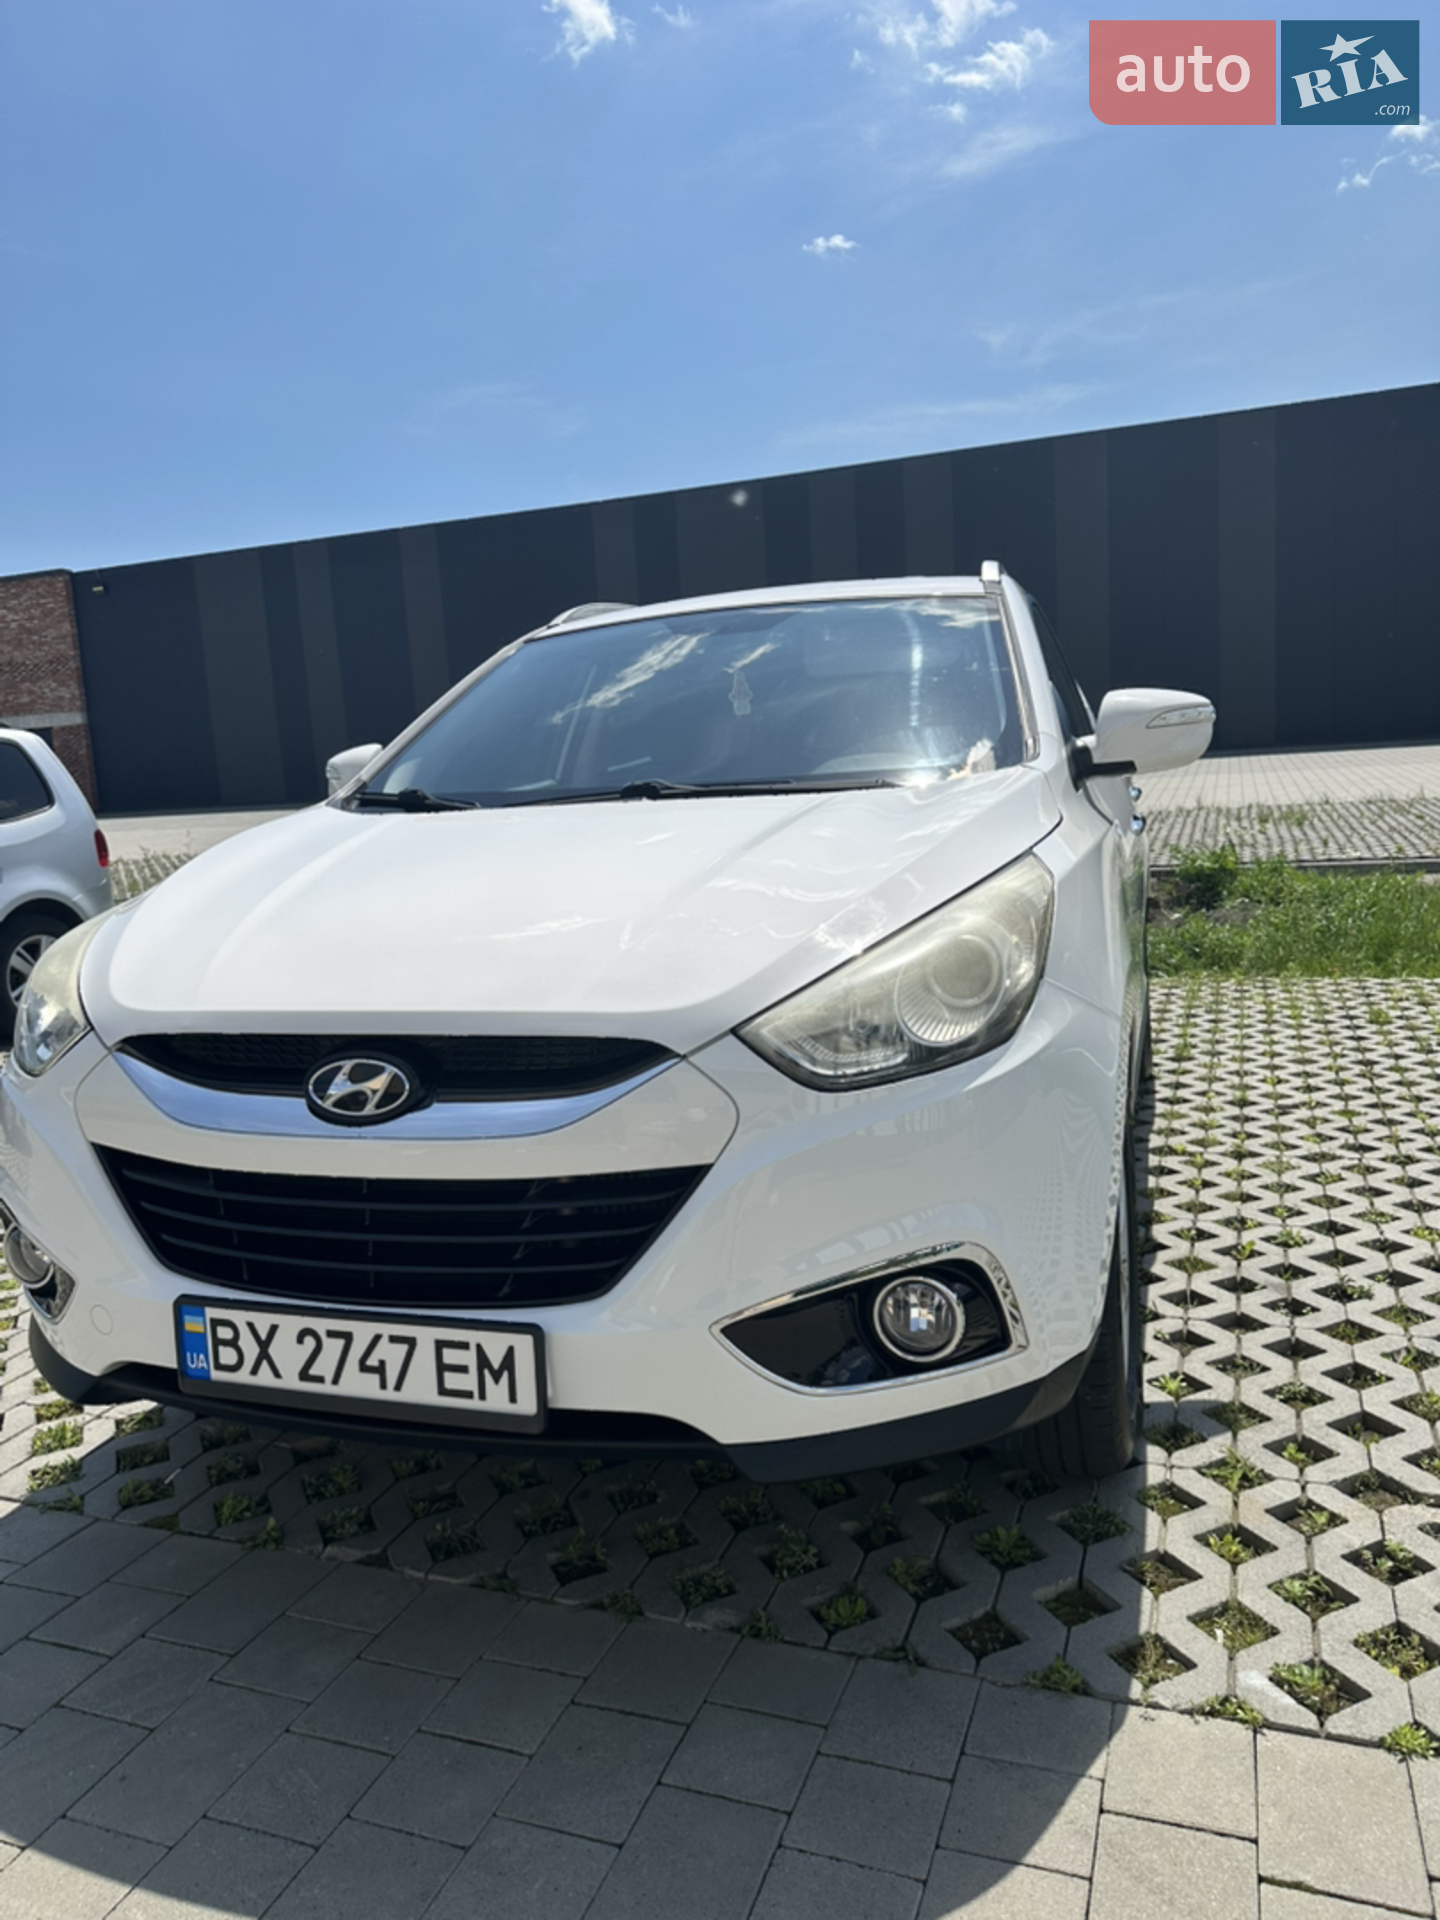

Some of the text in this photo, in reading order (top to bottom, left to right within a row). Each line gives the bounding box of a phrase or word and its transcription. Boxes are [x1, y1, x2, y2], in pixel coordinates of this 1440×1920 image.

[186, 1352, 208, 1370] UA
[210, 1317, 517, 1404] BX 2747 EM
